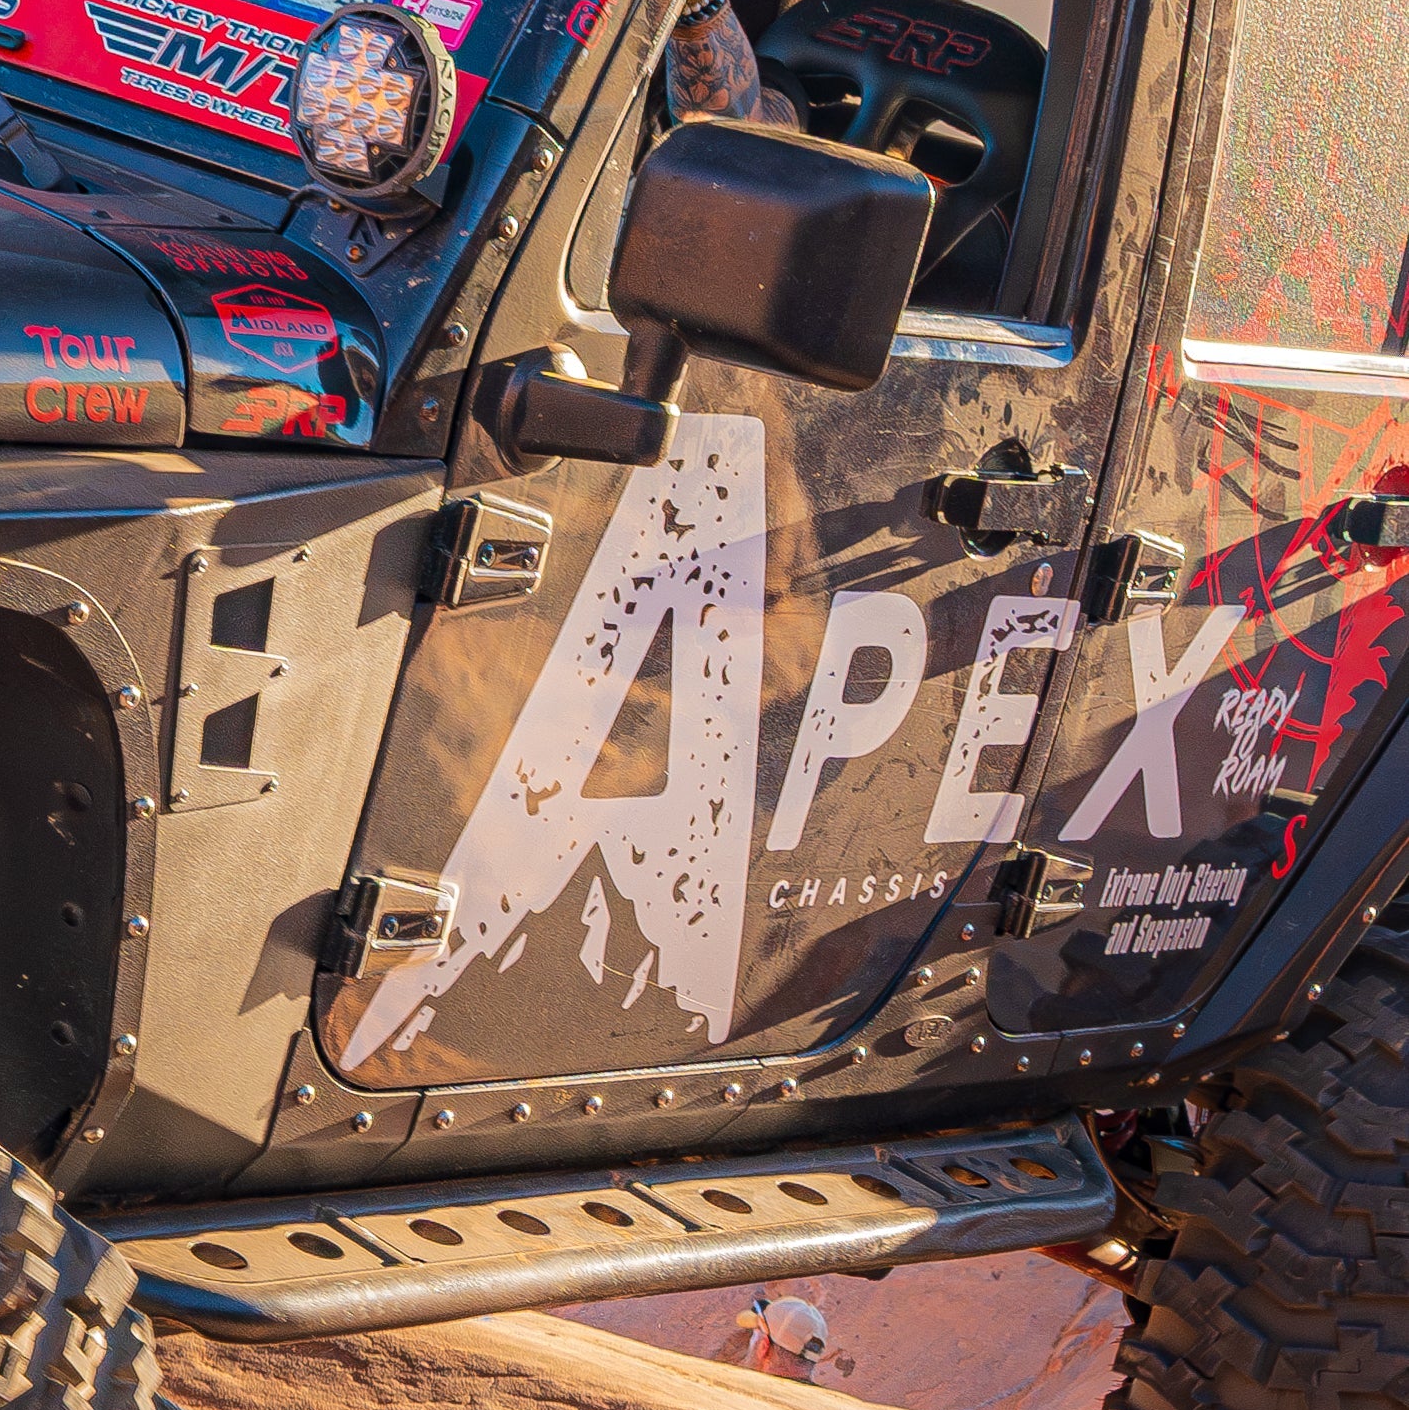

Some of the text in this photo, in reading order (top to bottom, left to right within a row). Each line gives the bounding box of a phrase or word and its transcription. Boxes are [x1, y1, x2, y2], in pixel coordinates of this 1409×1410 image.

[120, 67, 292, 134] TIRES & WHEEL
[174, 256, 309, 281] OFFROAD
[230, 310, 329, 336] MIDLAND
[24, 324, 136, 374] Tour
[25, 376, 150, 425] Crew
[1213, 687, 1303, 735] READY
[338, 413, 1249, 1071] APEX
[1228, 722, 1260, 760] TO
[1212, 754, 1288, 802] ROAM
[768, 868, 949, 910] CHASSIS
[1098, 861, 1250, 911] Extreme Duty Steering
[1104, 911, 1212, 959] and Suspension
